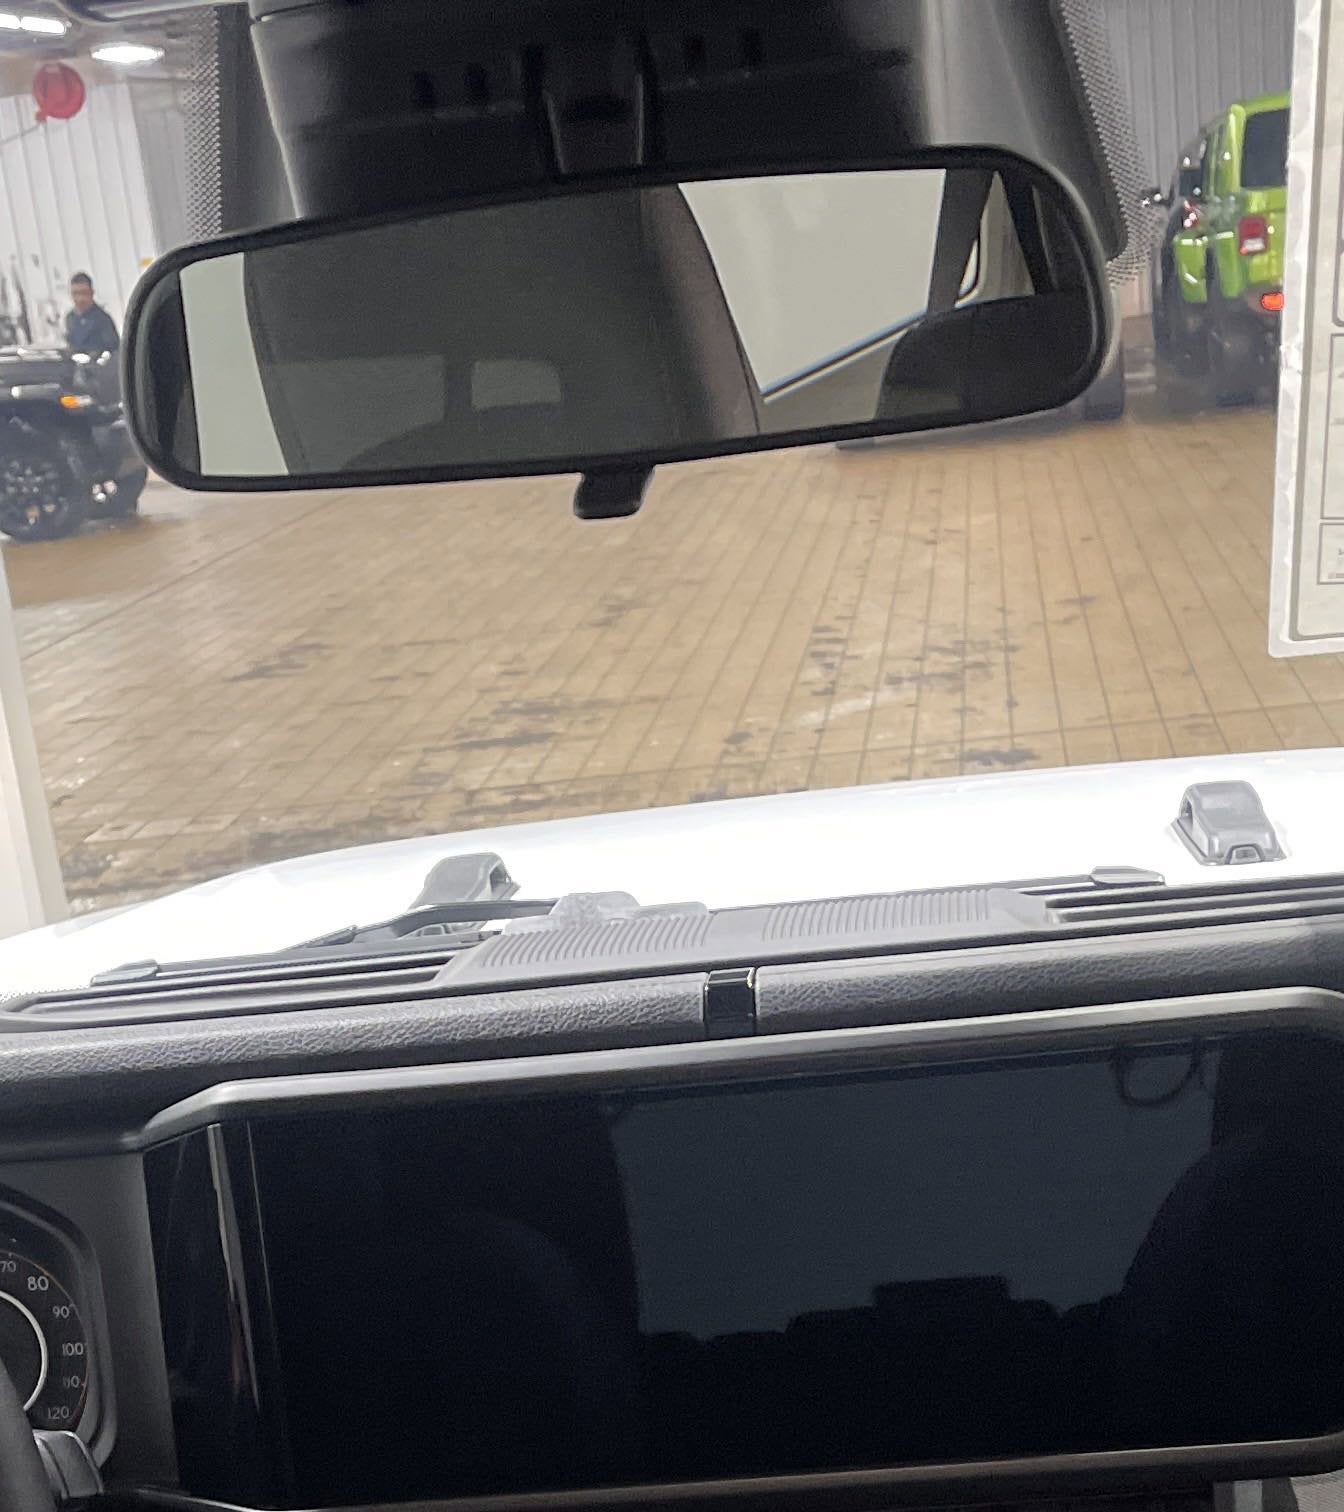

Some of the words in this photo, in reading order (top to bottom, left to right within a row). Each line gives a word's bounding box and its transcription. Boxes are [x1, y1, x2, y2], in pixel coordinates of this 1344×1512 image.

[0, 1259, 17, 1274] 70
[27, 1275, 50, 1292] 80
[52, 1304, 70, 1319] 90
[61, 1342, 85, 1357] 100
[47, 1405, 71, 1421] 120
